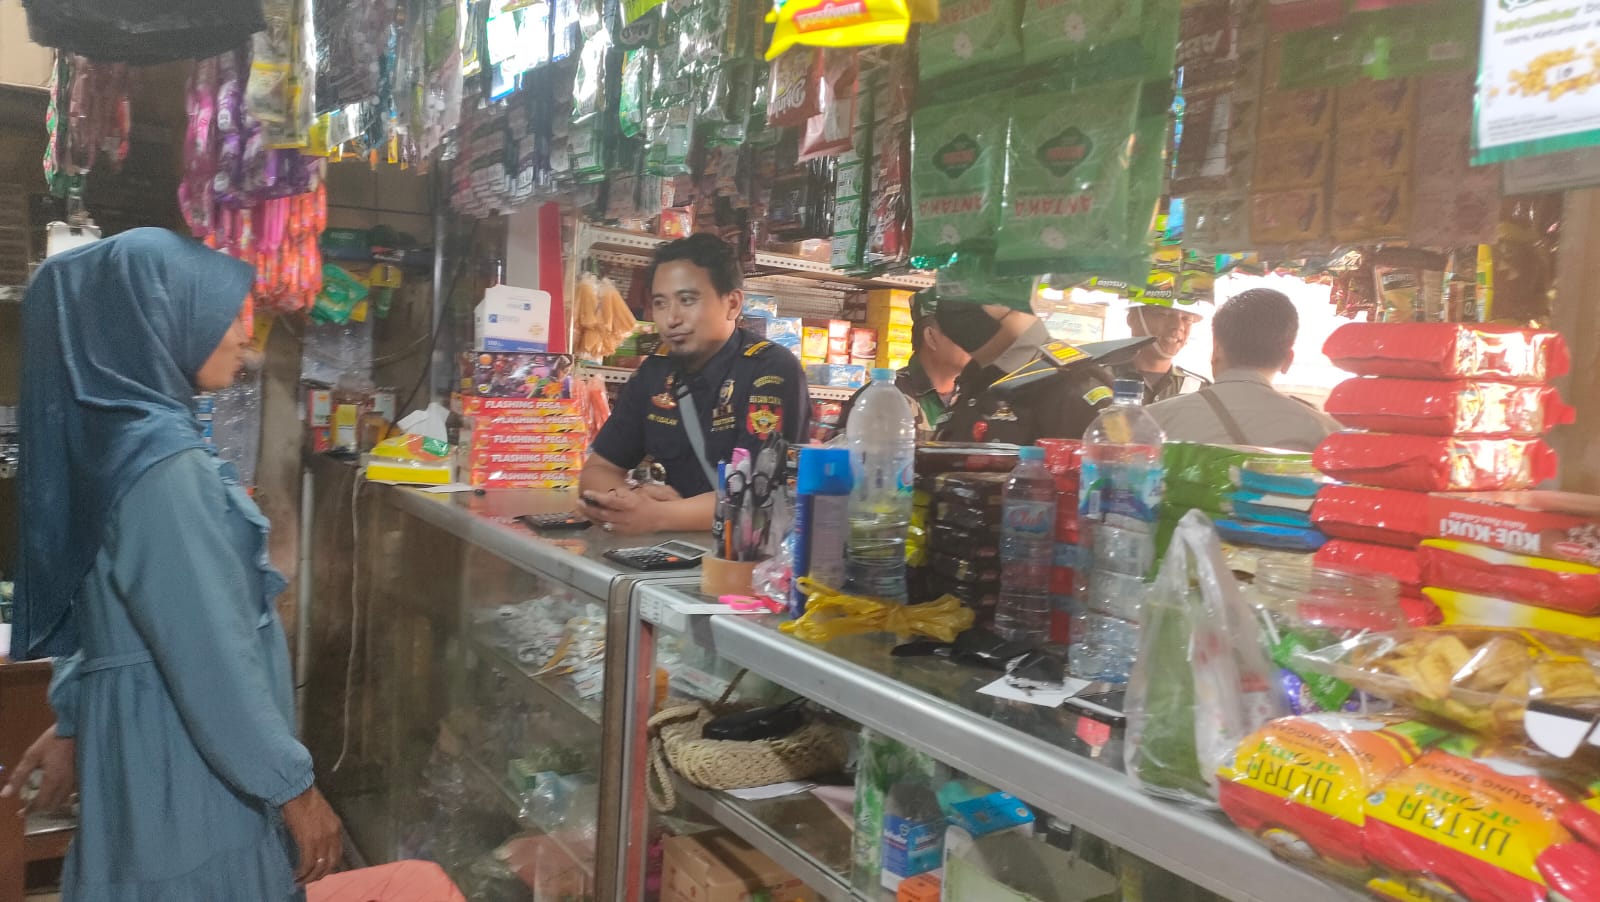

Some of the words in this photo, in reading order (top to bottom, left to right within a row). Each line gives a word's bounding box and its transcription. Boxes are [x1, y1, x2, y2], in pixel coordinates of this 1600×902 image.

[485, 401, 534, 409] FLASHING
[536, 401, 561, 409] PEGA
[493, 435, 542, 444] FLASHING
[544, 436, 569, 444] PEGA
[491, 454, 541, 463] FLASHING
[542, 455, 567, 463] PEGA
[489, 472, 538, 481] ASHING
[1246, 756, 1334, 804] ULTRA
[1396, 794, 1512, 857] ULTRA
